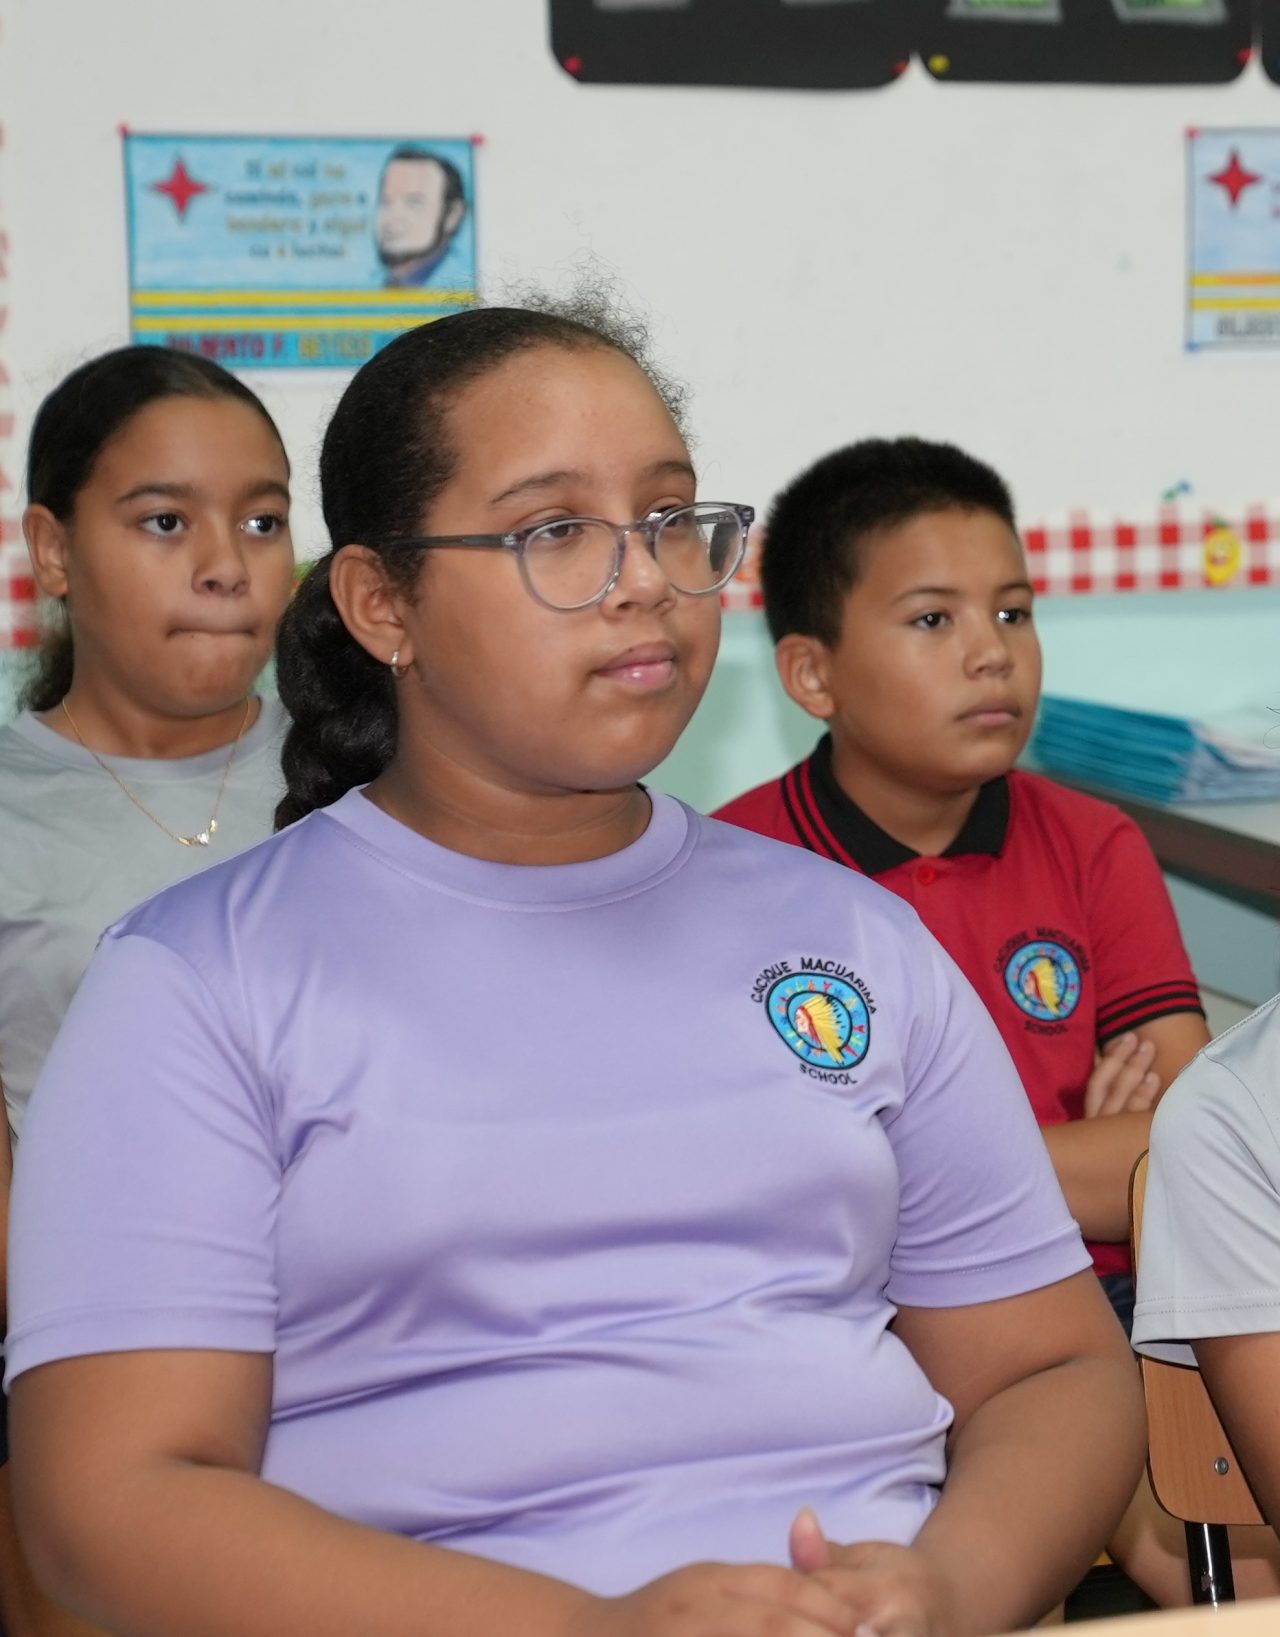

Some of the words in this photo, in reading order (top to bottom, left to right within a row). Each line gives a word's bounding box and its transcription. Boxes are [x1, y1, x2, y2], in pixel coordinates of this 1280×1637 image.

[751, 961, 792, 1003] CACIQUE
[800, 957, 877, 1015] MACUARIMA
[800, 1063, 858, 1085] SCHOOL
